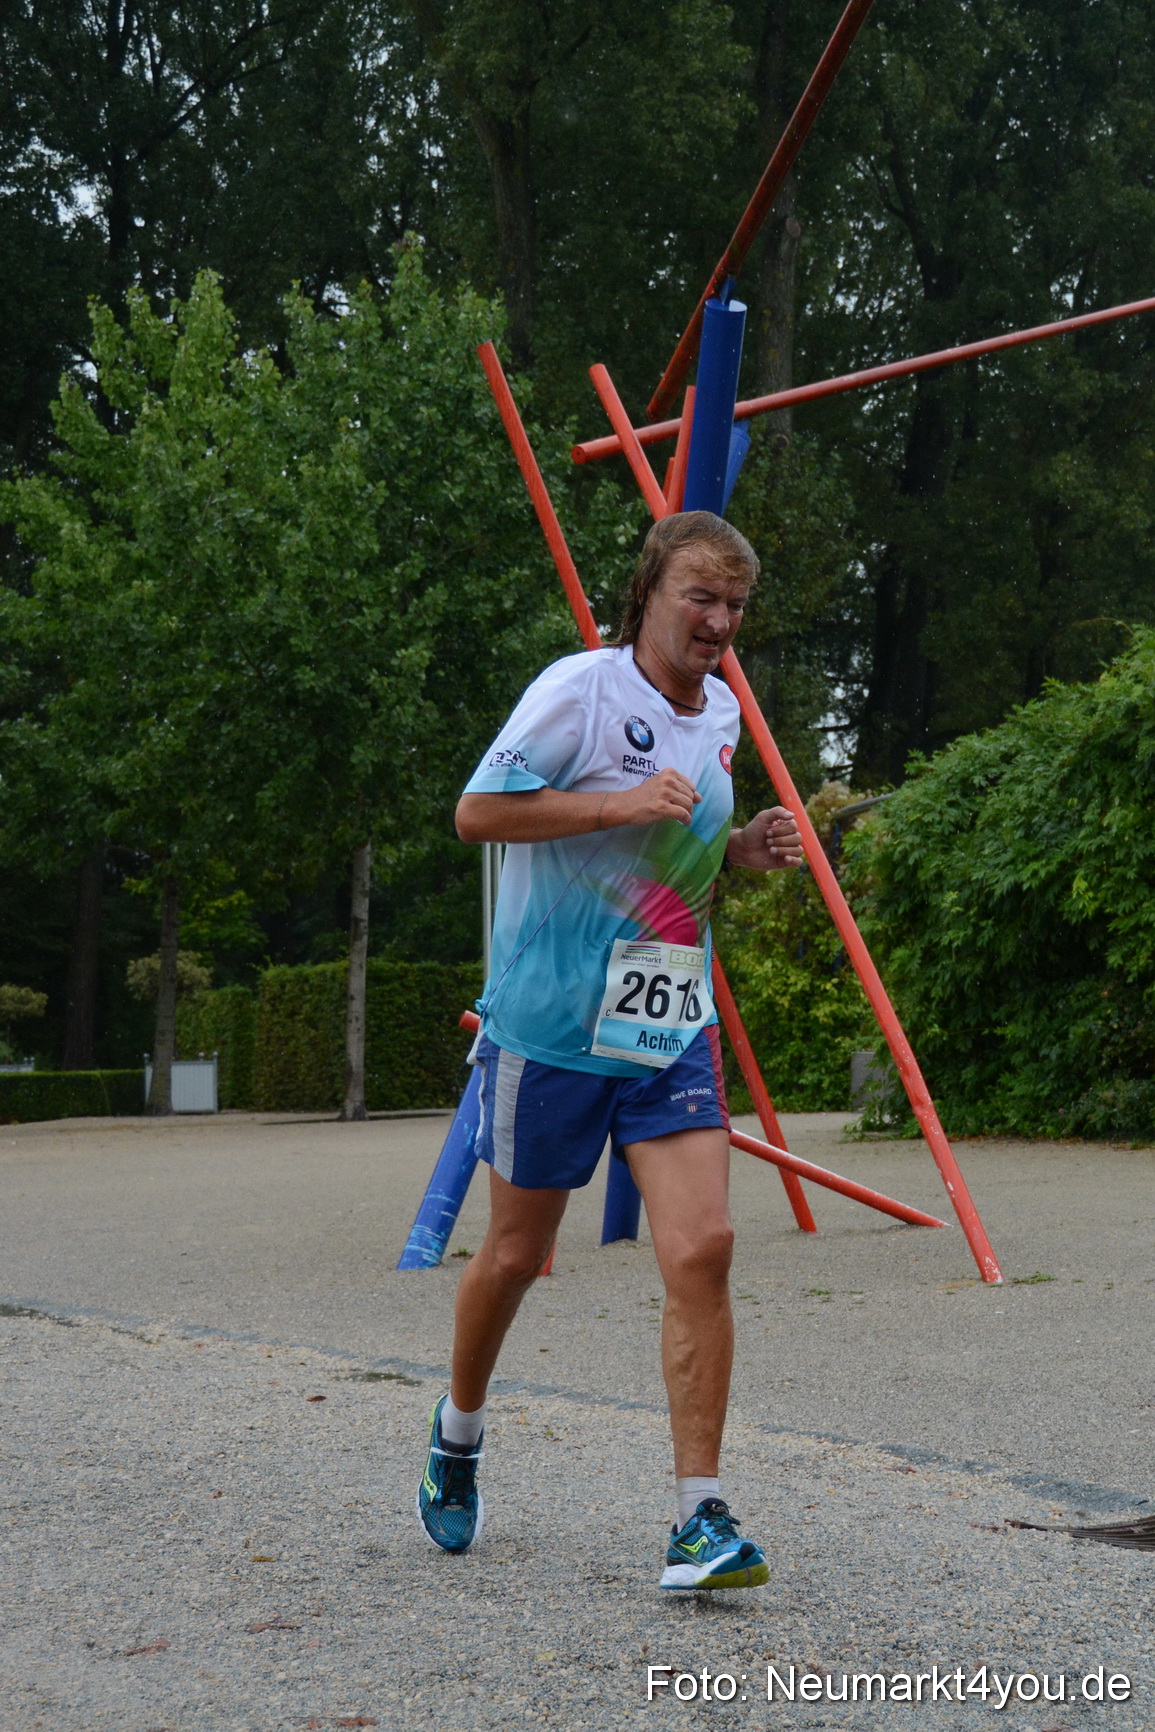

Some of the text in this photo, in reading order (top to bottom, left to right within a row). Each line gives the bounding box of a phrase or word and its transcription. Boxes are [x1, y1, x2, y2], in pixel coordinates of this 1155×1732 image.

[623, 755, 659, 772] PARTL
[621, 953, 661, 964] NeuerMarkt
[615, 970, 702, 1022] 2616
[636, 1030, 685, 1052] Achim
[670, 1090, 686, 1101] WAVE
[687, 1088, 712, 1096] BOARD
